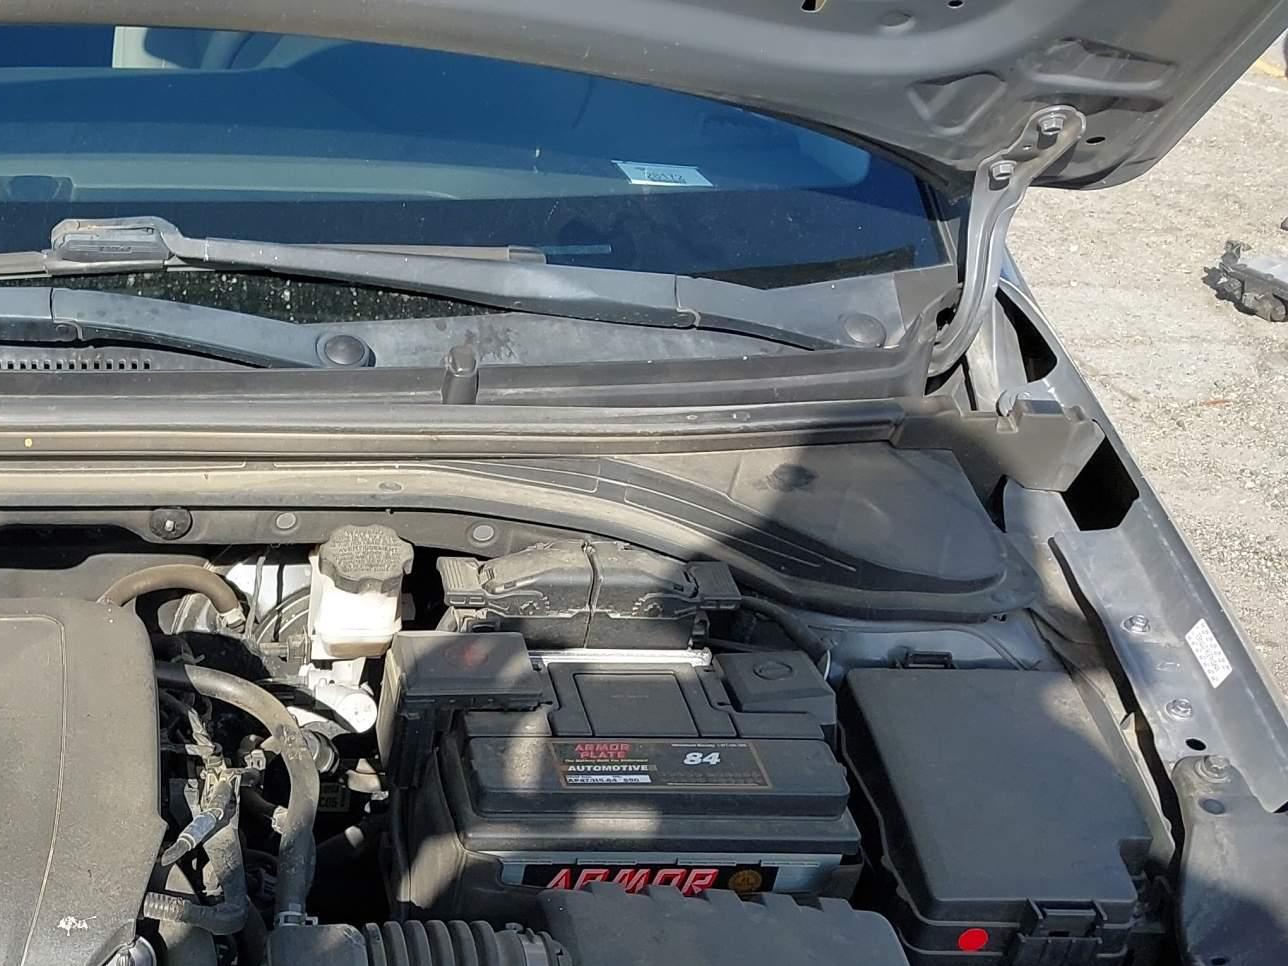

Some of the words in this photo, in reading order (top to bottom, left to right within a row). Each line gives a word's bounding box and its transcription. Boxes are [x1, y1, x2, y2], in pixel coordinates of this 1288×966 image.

[574, 743, 632, 751] ARMOR
[579, 751, 627, 759] PLATE
[683, 752, 721, 766] 84
[567, 764, 649, 772] AUTOMOTIVE
